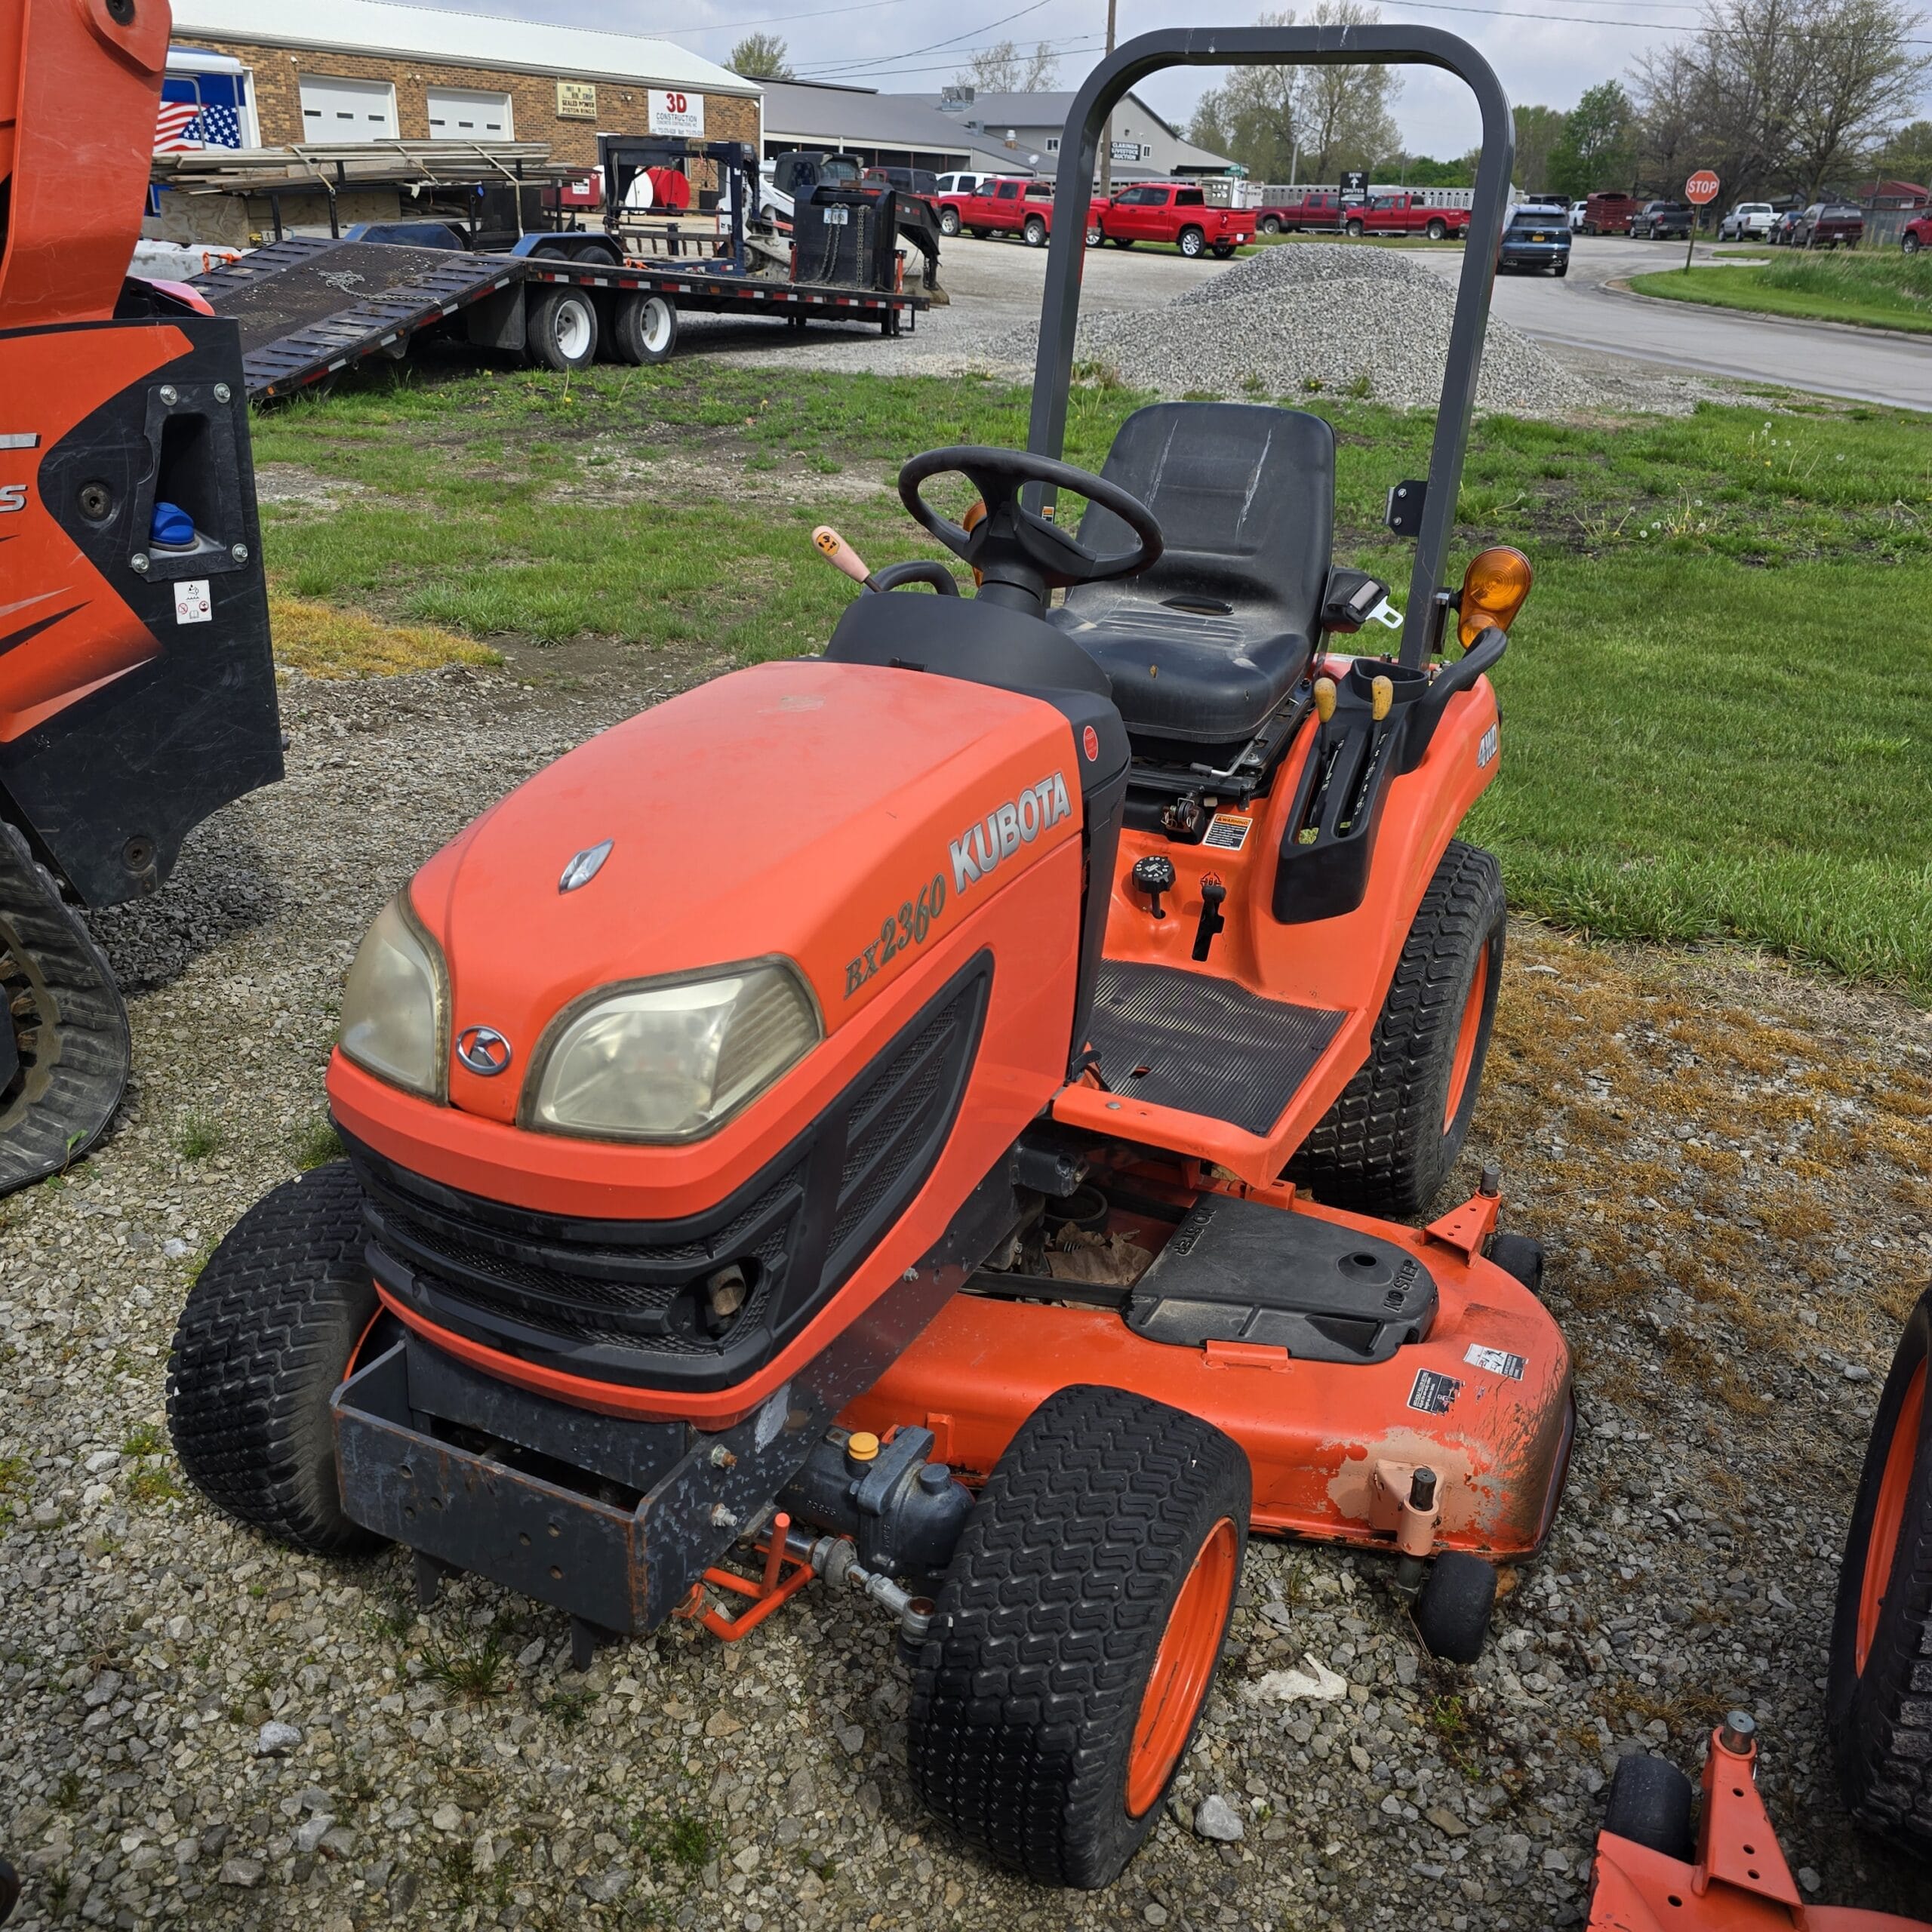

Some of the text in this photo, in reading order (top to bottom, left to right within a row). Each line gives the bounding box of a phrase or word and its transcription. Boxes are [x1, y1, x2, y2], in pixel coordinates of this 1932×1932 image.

[666, 93, 687, 113] 3D
[656, 112, 697, 122] CONSTRUCTION
[1112, 147, 1139, 155] LIVESTOCK
[1687, 180, 1718, 194] STOP
[1222, 817, 1249, 826] WARNING
[949, 771, 1072, 895] KUBOTA
[844, 872, 947, 1001] BX2360
[1382, 1258, 1420, 1313] NO STEP
